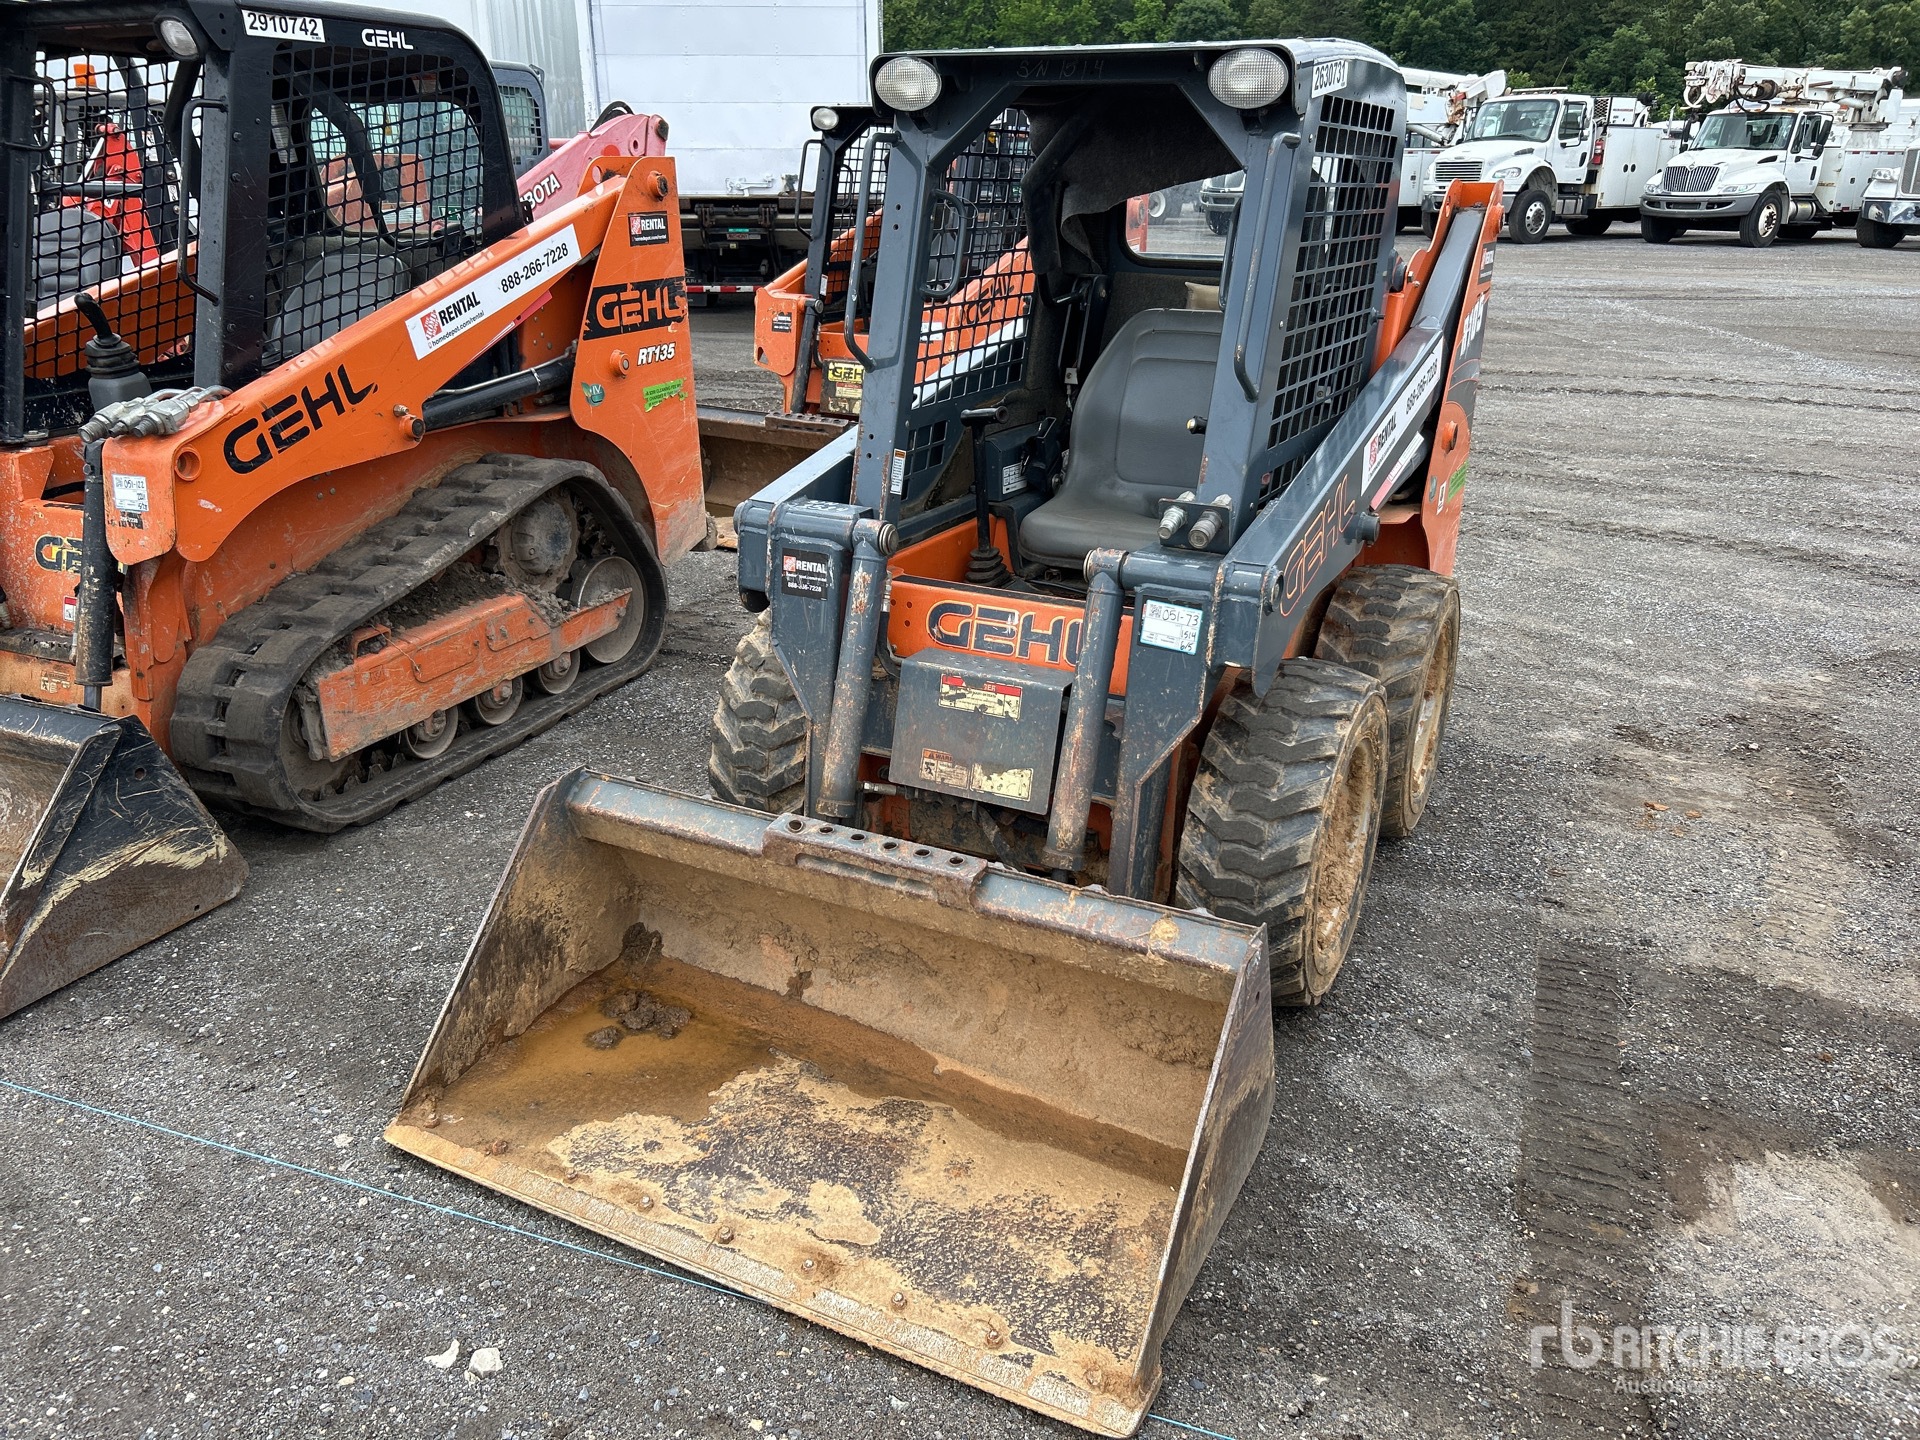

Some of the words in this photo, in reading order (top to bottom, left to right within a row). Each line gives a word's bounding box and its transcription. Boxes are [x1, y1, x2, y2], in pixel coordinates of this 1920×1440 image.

[248, 12, 319, 36] 2910742
[361, 28, 414, 50] GEHL
[1314, 60, 1346, 91] 2630731
[640, 218, 666, 230] RENTAL
[501, 242, 569, 294] 888-266-7228
[438, 291, 481, 327] RENTAL
[596, 284, 685, 329] GEHL
[432, 310, 485, 347] homedepot.com/rental
[637, 342, 676, 366] RT135
[223, 363, 379, 475] GEHL
[1377, 411, 1397, 453] RENTAL
[1280, 474, 1356, 617] GEHL
[796, 559, 828, 575] RENTAL
[1162, 609, 1200, 627] 051-73
[1180, 630, 1196, 642] 1514
